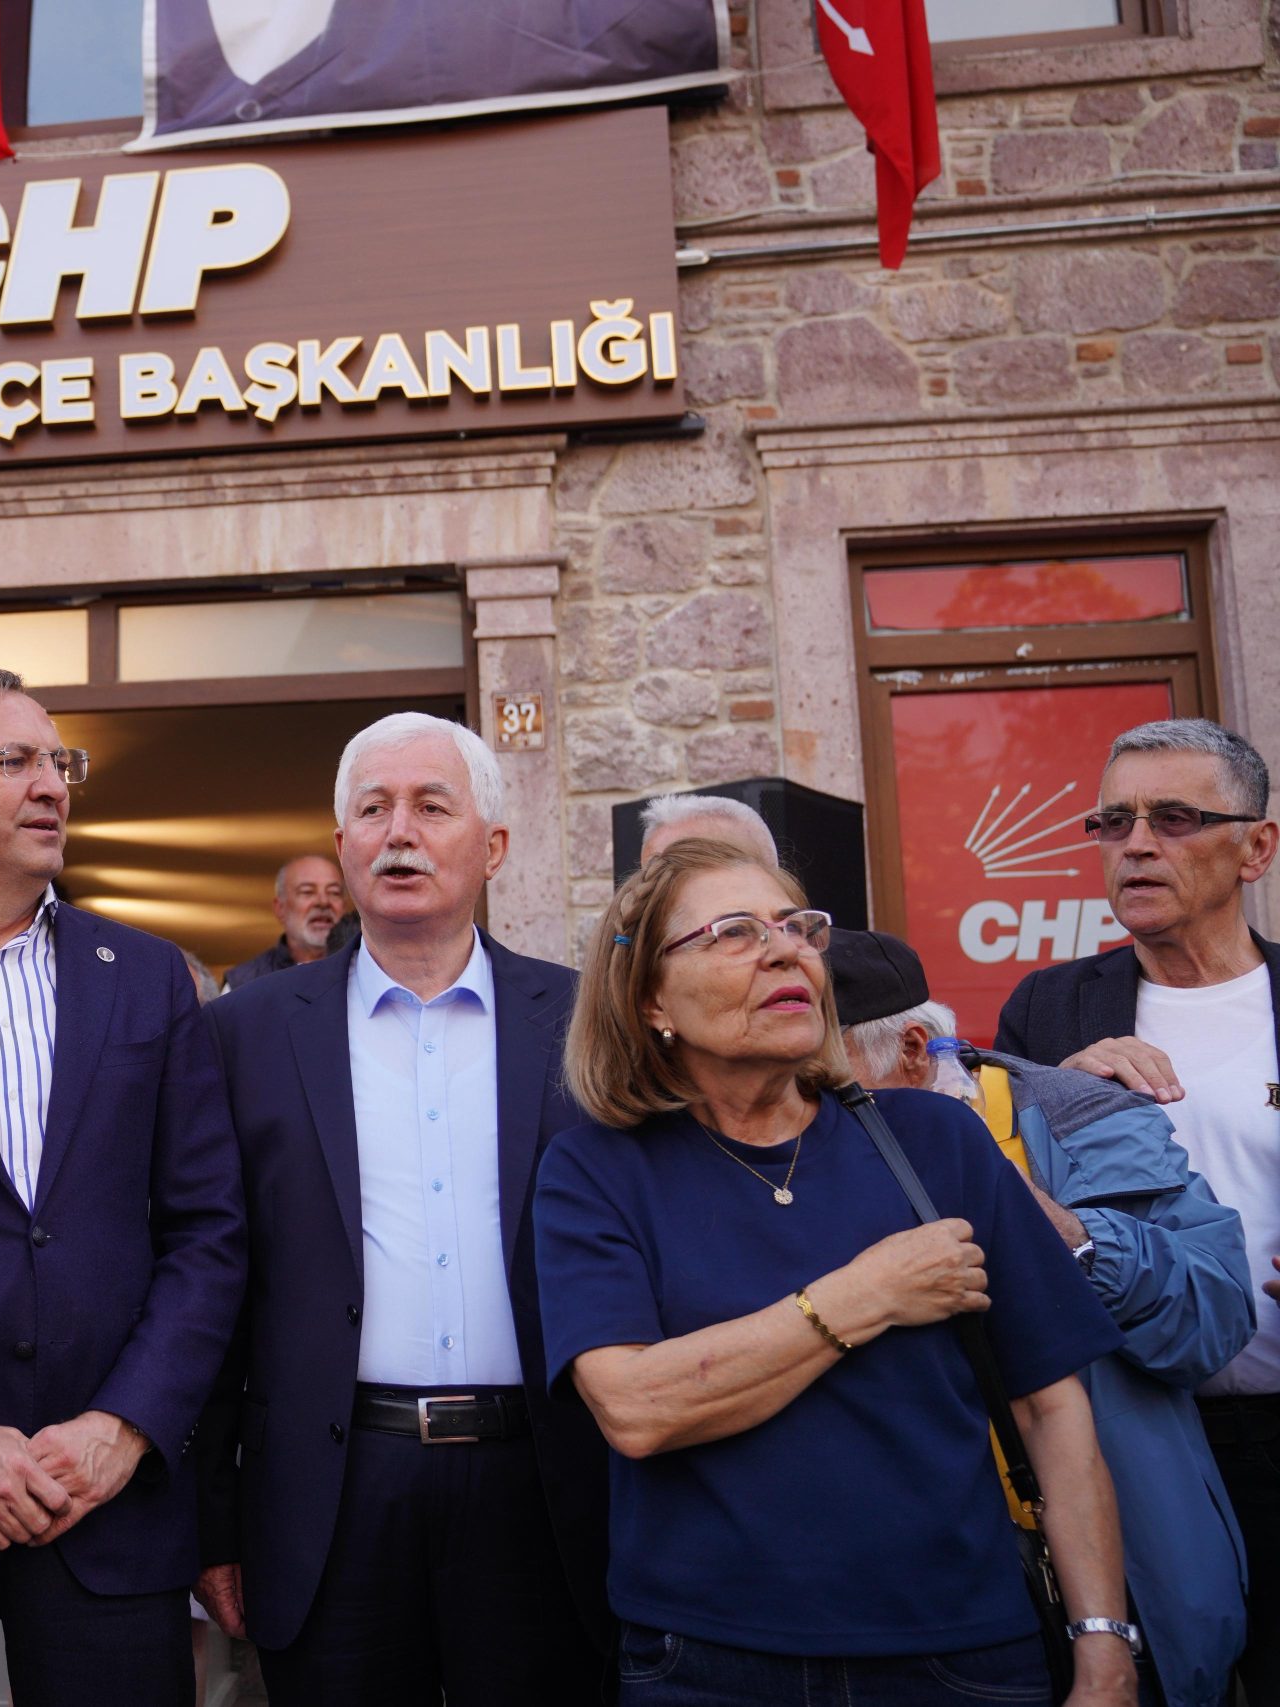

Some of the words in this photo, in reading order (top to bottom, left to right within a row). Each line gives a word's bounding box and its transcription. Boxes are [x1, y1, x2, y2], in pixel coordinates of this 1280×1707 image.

[118, 297, 678, 424] BAŞKANLIĞI
[503, 703, 536, 734] 37
[958, 898, 1130, 963] CHP
